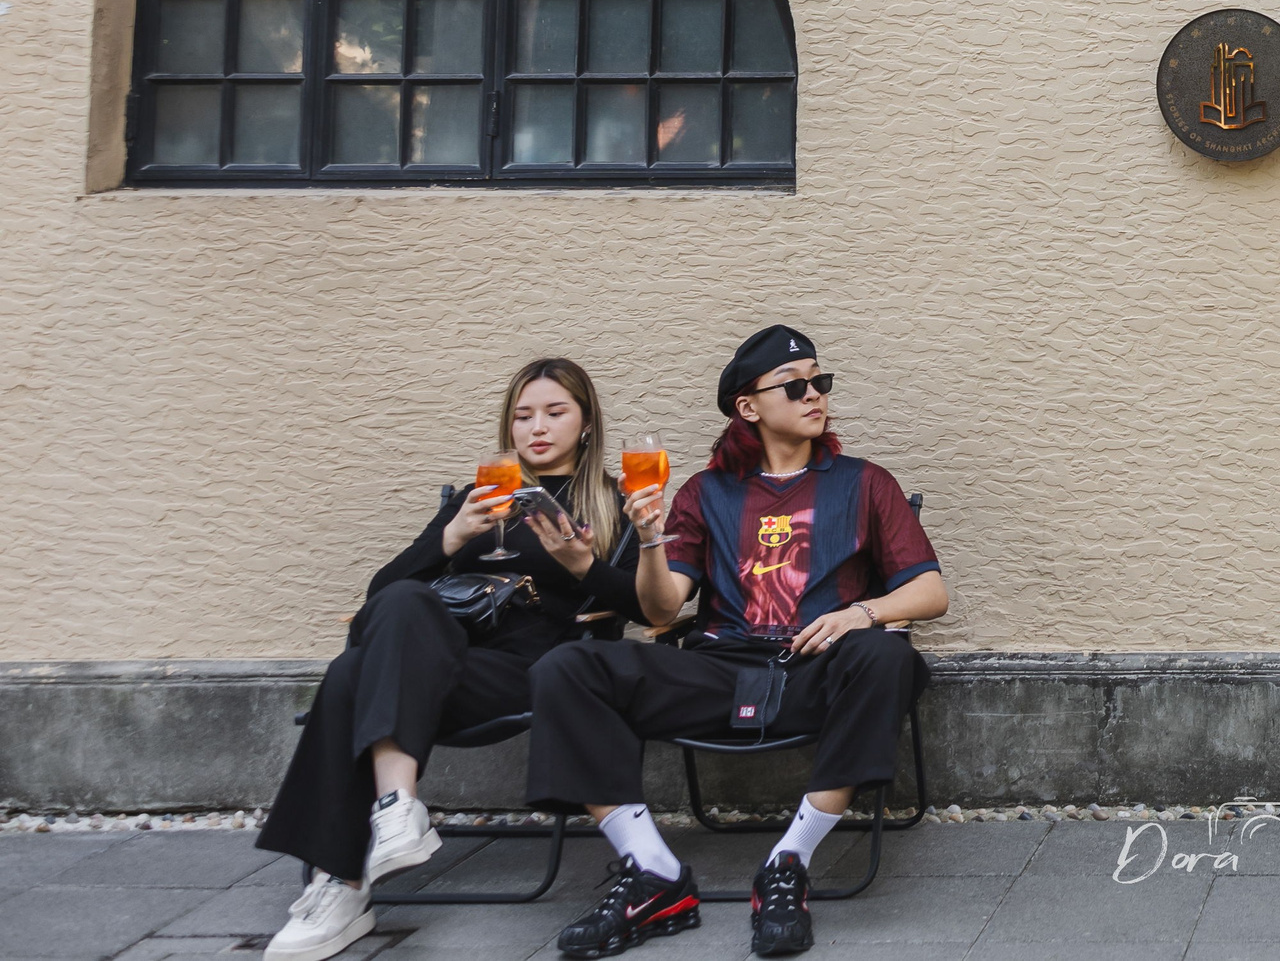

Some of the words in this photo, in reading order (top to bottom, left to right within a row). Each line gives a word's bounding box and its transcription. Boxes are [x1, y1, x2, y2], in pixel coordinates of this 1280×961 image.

[1165, 93, 1189, 132] STORIES
[1189, 132, 1202, 142] OF
[1204, 141, 1252, 153] SHANGHAI
